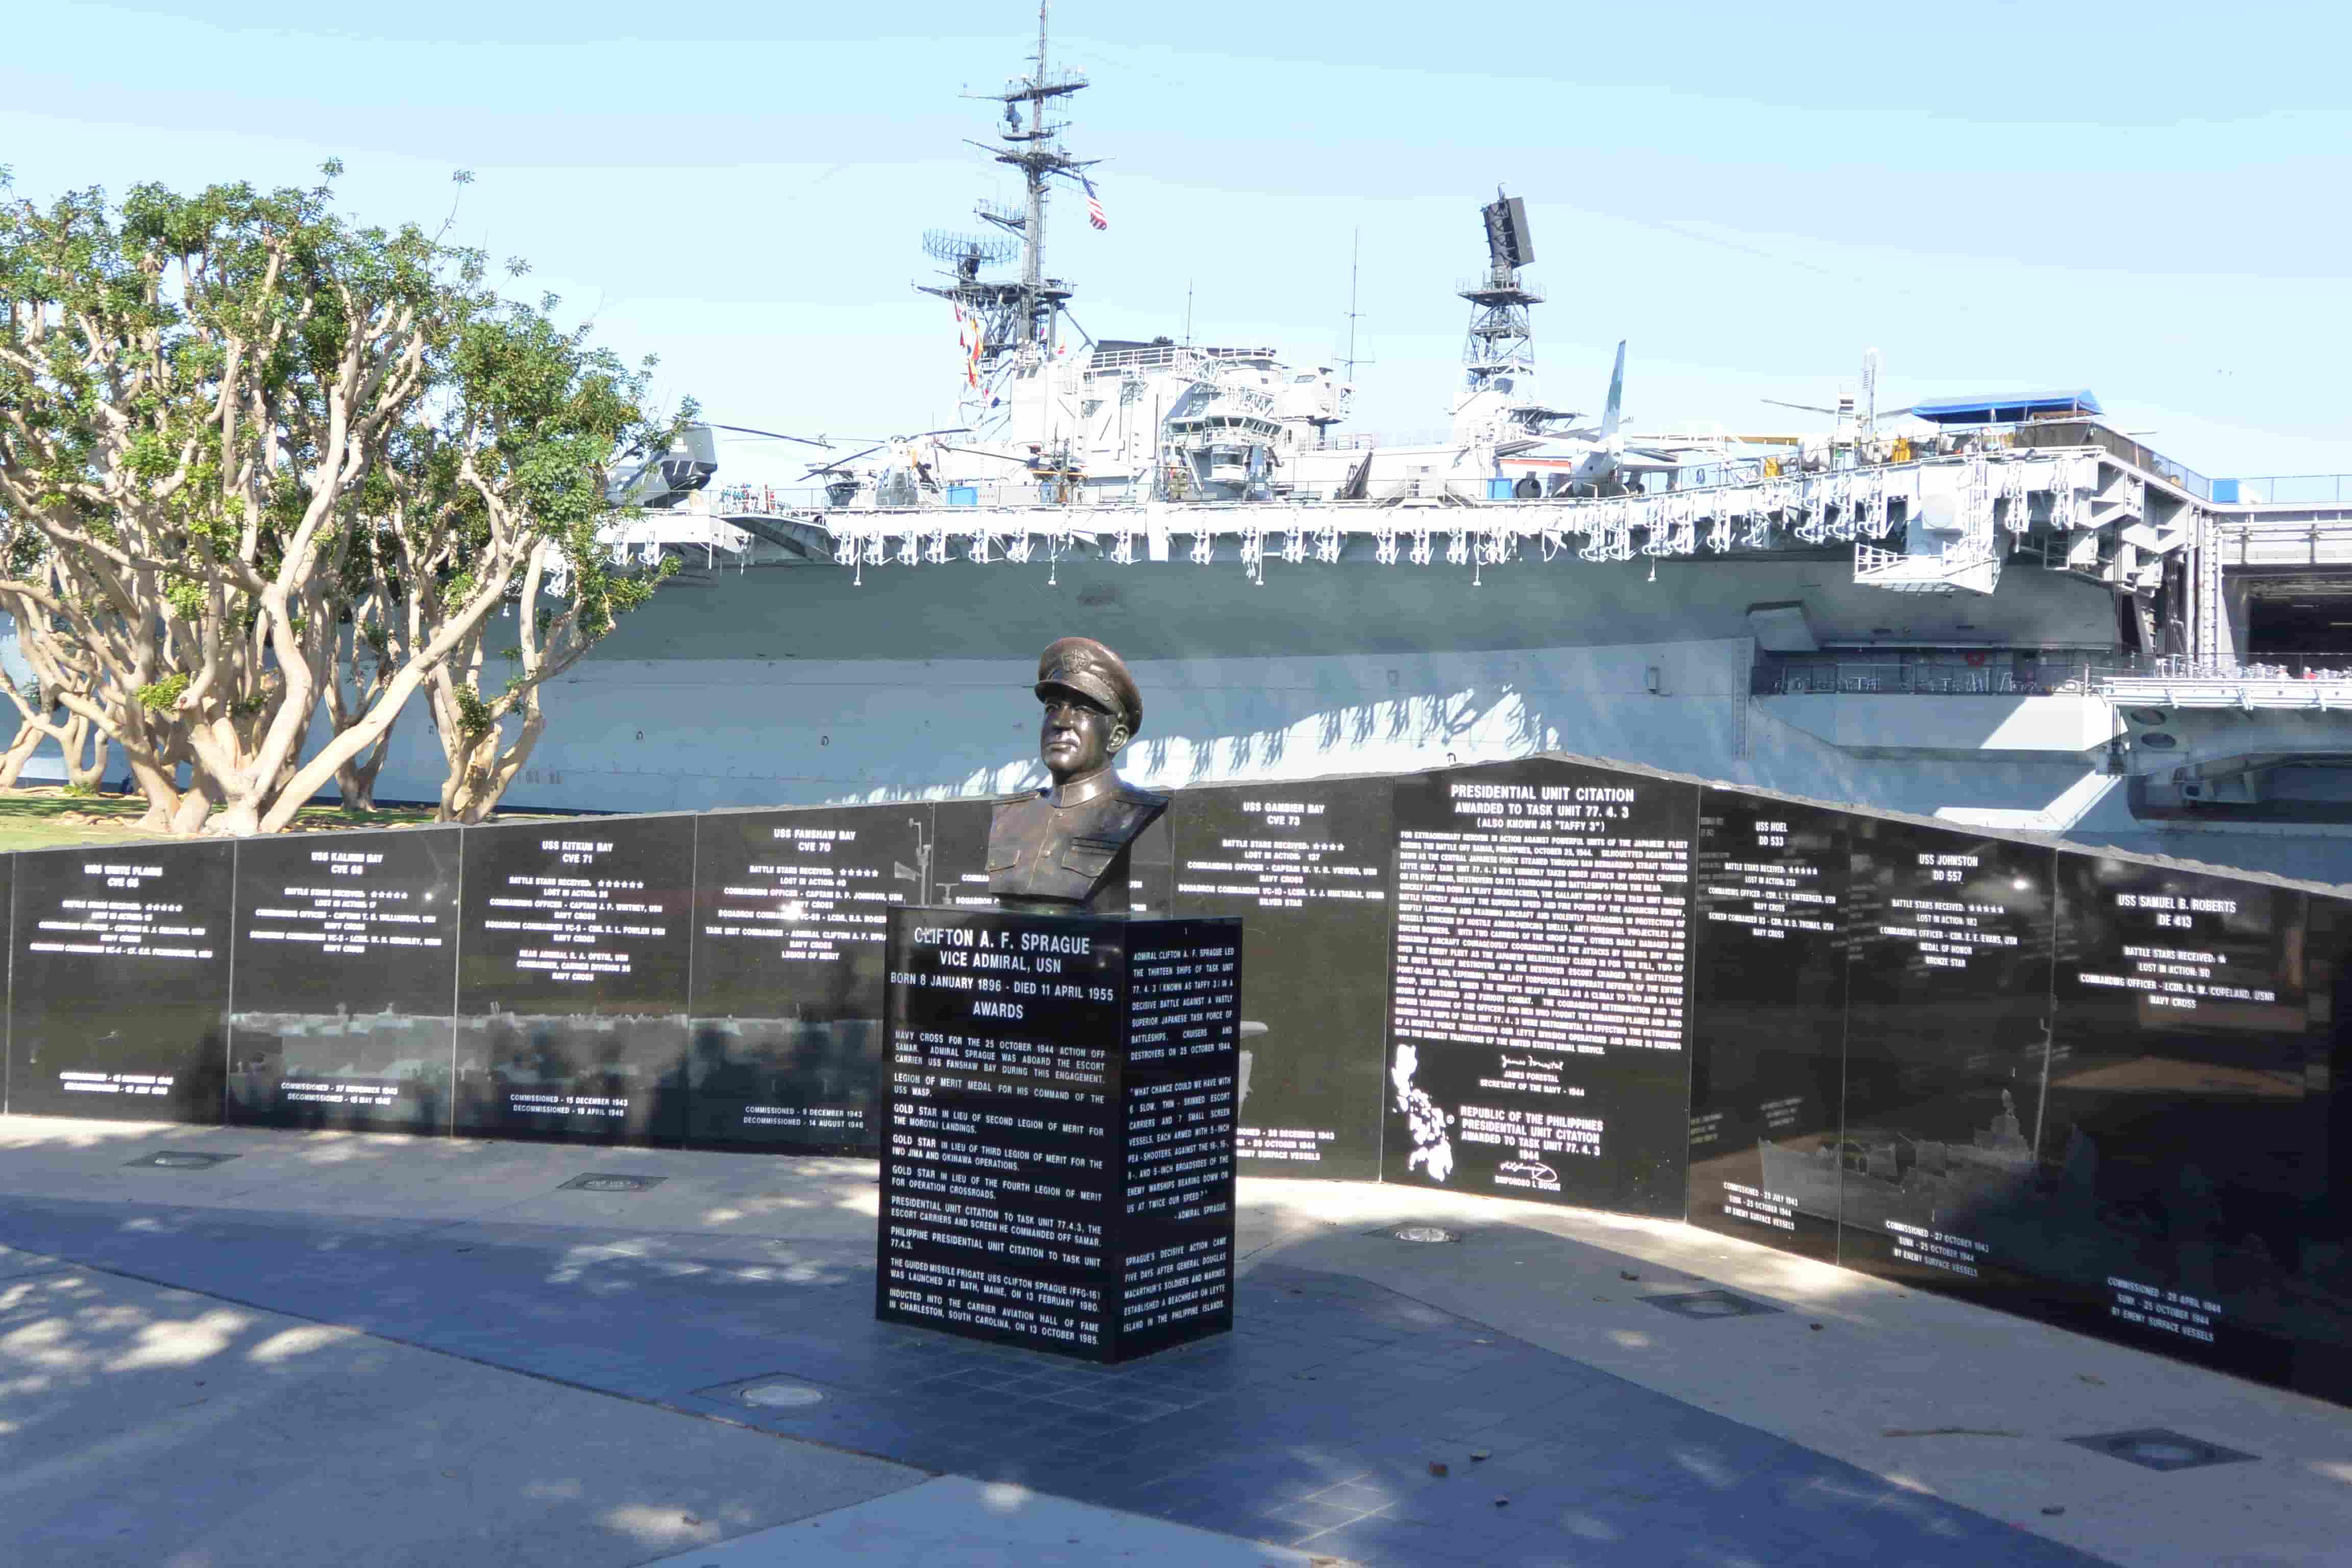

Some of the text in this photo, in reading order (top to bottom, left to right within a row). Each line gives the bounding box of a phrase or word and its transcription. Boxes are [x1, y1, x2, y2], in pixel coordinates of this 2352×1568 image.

[1451, 784, 1634, 801] PRESIDENTIAL UNIT CITATION
[1455, 802, 1629, 818] AWARDED TO TASK UNIT 77. 4. 3
[1477, 818, 1605, 832] (ALSO KNOWN AS "TAFFY 3")
[1755, 821, 1787, 832] USS HOEL
[773, 828, 856, 841] USS FANSHAW BAY
[1758, 835, 1783, 847] DD 533
[542, 840, 559, 851] USS
[596, 842, 613, 852] BAY
[798, 841, 830, 852] CVE 70
[562, 853, 592, 865] CVE 71
[1919, 854, 1978, 867] USS JOHNSTON
[1932, 870, 1962, 881] DD 557
[2117, 894, 2236, 912] USS SAMUEL B. ROBERTS
[2157, 914, 2192, 927] DE 413
[914, 928, 1089, 954] CLIFTON A. F. SPRAGUE
[1941, 944, 1949, 953] OF
[1950, 944, 1972, 954] HONOR
[2124, 946, 2215, 962] BATTLE STARS RECEIVED:
[940, 951, 1061, 973] VICE ADMIRAL, USN
[1950, 958, 1966, 968] STAR
[891, 972, 916, 985] BORN
[920, 975, 925, 986] 8
[930, 976, 973, 989] JANUARY
[978, 979, 1001, 992] 1896
[1014, 983, 1036, 994] DIED
[1041, 985, 1049, 995] 11
[1055, 986, 1083, 998] APRIL
[1089, 989, 1113, 1000] 1955
[2149, 996, 2196, 1007] NAVY CROSS
[973, 1003, 1023, 1019] AWARDS
[895, 1031, 1105, 1058] NAVY CROSS FOR THE 25 OCTOBER 1944 ACTION OFF
[1526, 1072, 1559, 1082] FORESTAL
[1517, 1082, 1527, 1092] OF
[1529, 1083, 1542, 1093] THE
[510, 1093, 558, 1104] COMMISSIONED
[566, 1095, 573, 1105] 15
[575, 1096, 609, 1106] DECEMBER
[612, 1097, 628, 1107] 1943
[745, 1106, 794, 1115] COMMISSIONED
[809, 1108, 843, 1117] DECEMBER
[847, 1109, 862, 1118] 1943
[1460, 1106, 1603, 1132] REPUBLIC OF THE PHILIPPINES
[1461, 1119, 1600, 1143] PRESIDENTIAL UNIT CITATION
[1461, 1131, 1600, 1156] AWARDED TO TASK UNIT 77. 4. 3
[890, 1270, 1098, 1312] WAS LAUNCHED AT BATH, MAINE, ON 13 FEBRUARY 1980.
[889, 1301, 1098, 1345] IN CHARLESTON, SOUTH CAROLINA, ON 13 OCTOBER 1985.
